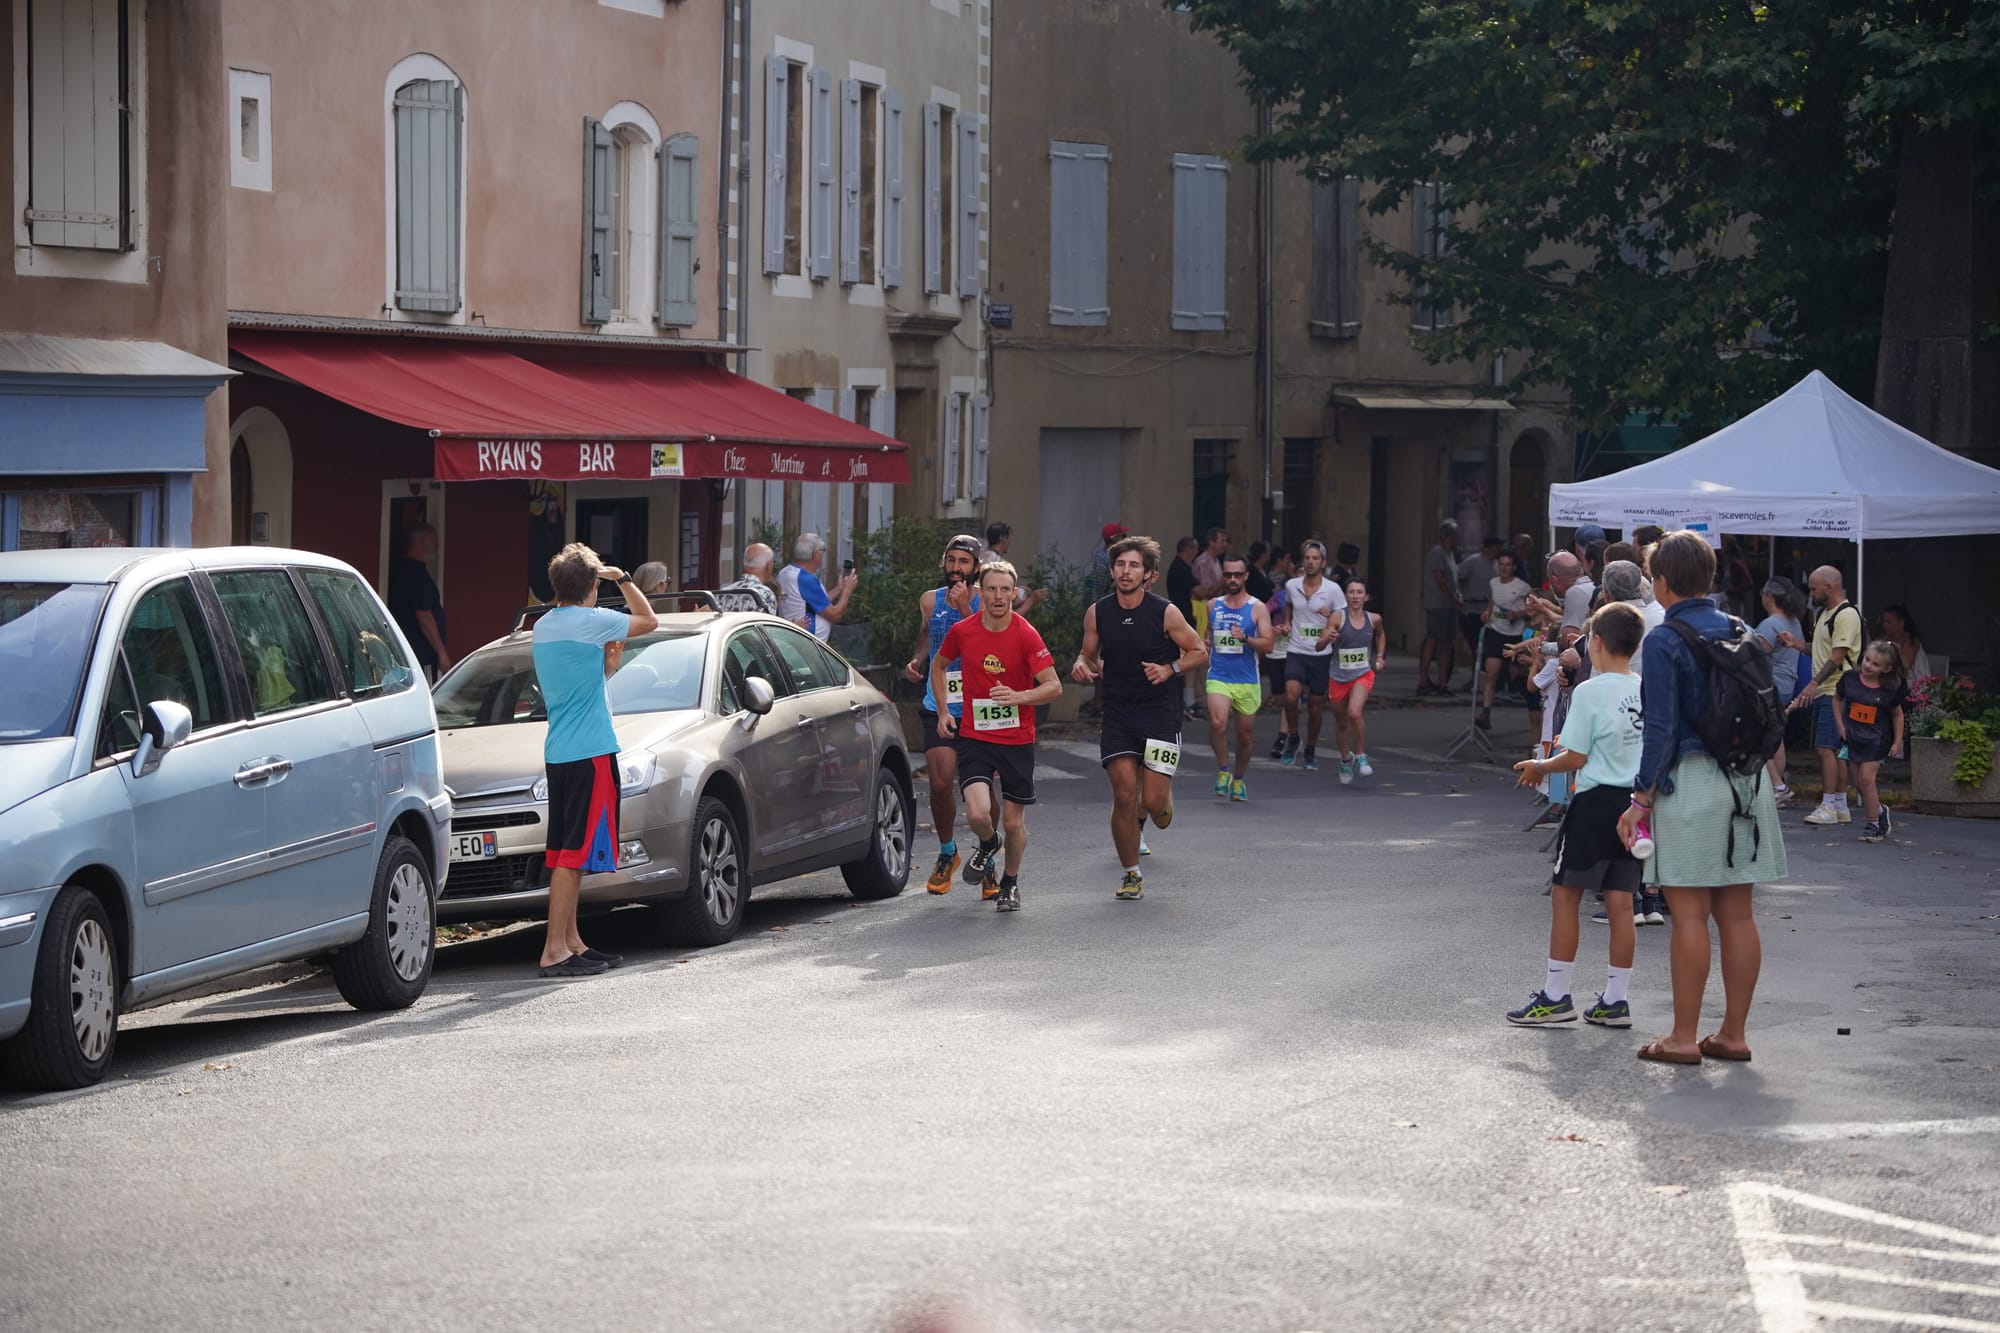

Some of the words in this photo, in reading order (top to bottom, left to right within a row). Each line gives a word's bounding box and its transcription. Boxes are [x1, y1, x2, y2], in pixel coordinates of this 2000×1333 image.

[478, 441, 542, 472] RYAN'S
[579, 442, 615, 472] BAR
[724, 447, 746, 472] Chez
[771, 452, 805, 475] Martine
[821, 458, 830, 475] et
[849, 454, 868, 481] John
[1220, 636, 1236, 646] 46
[1343, 653, 1365, 663] 192
[980, 706, 1013, 720] 153
[1152, 748, 1178, 766] 185
[449, 837, 482, 857] -EQ
[485, 845, 495, 855] 48
